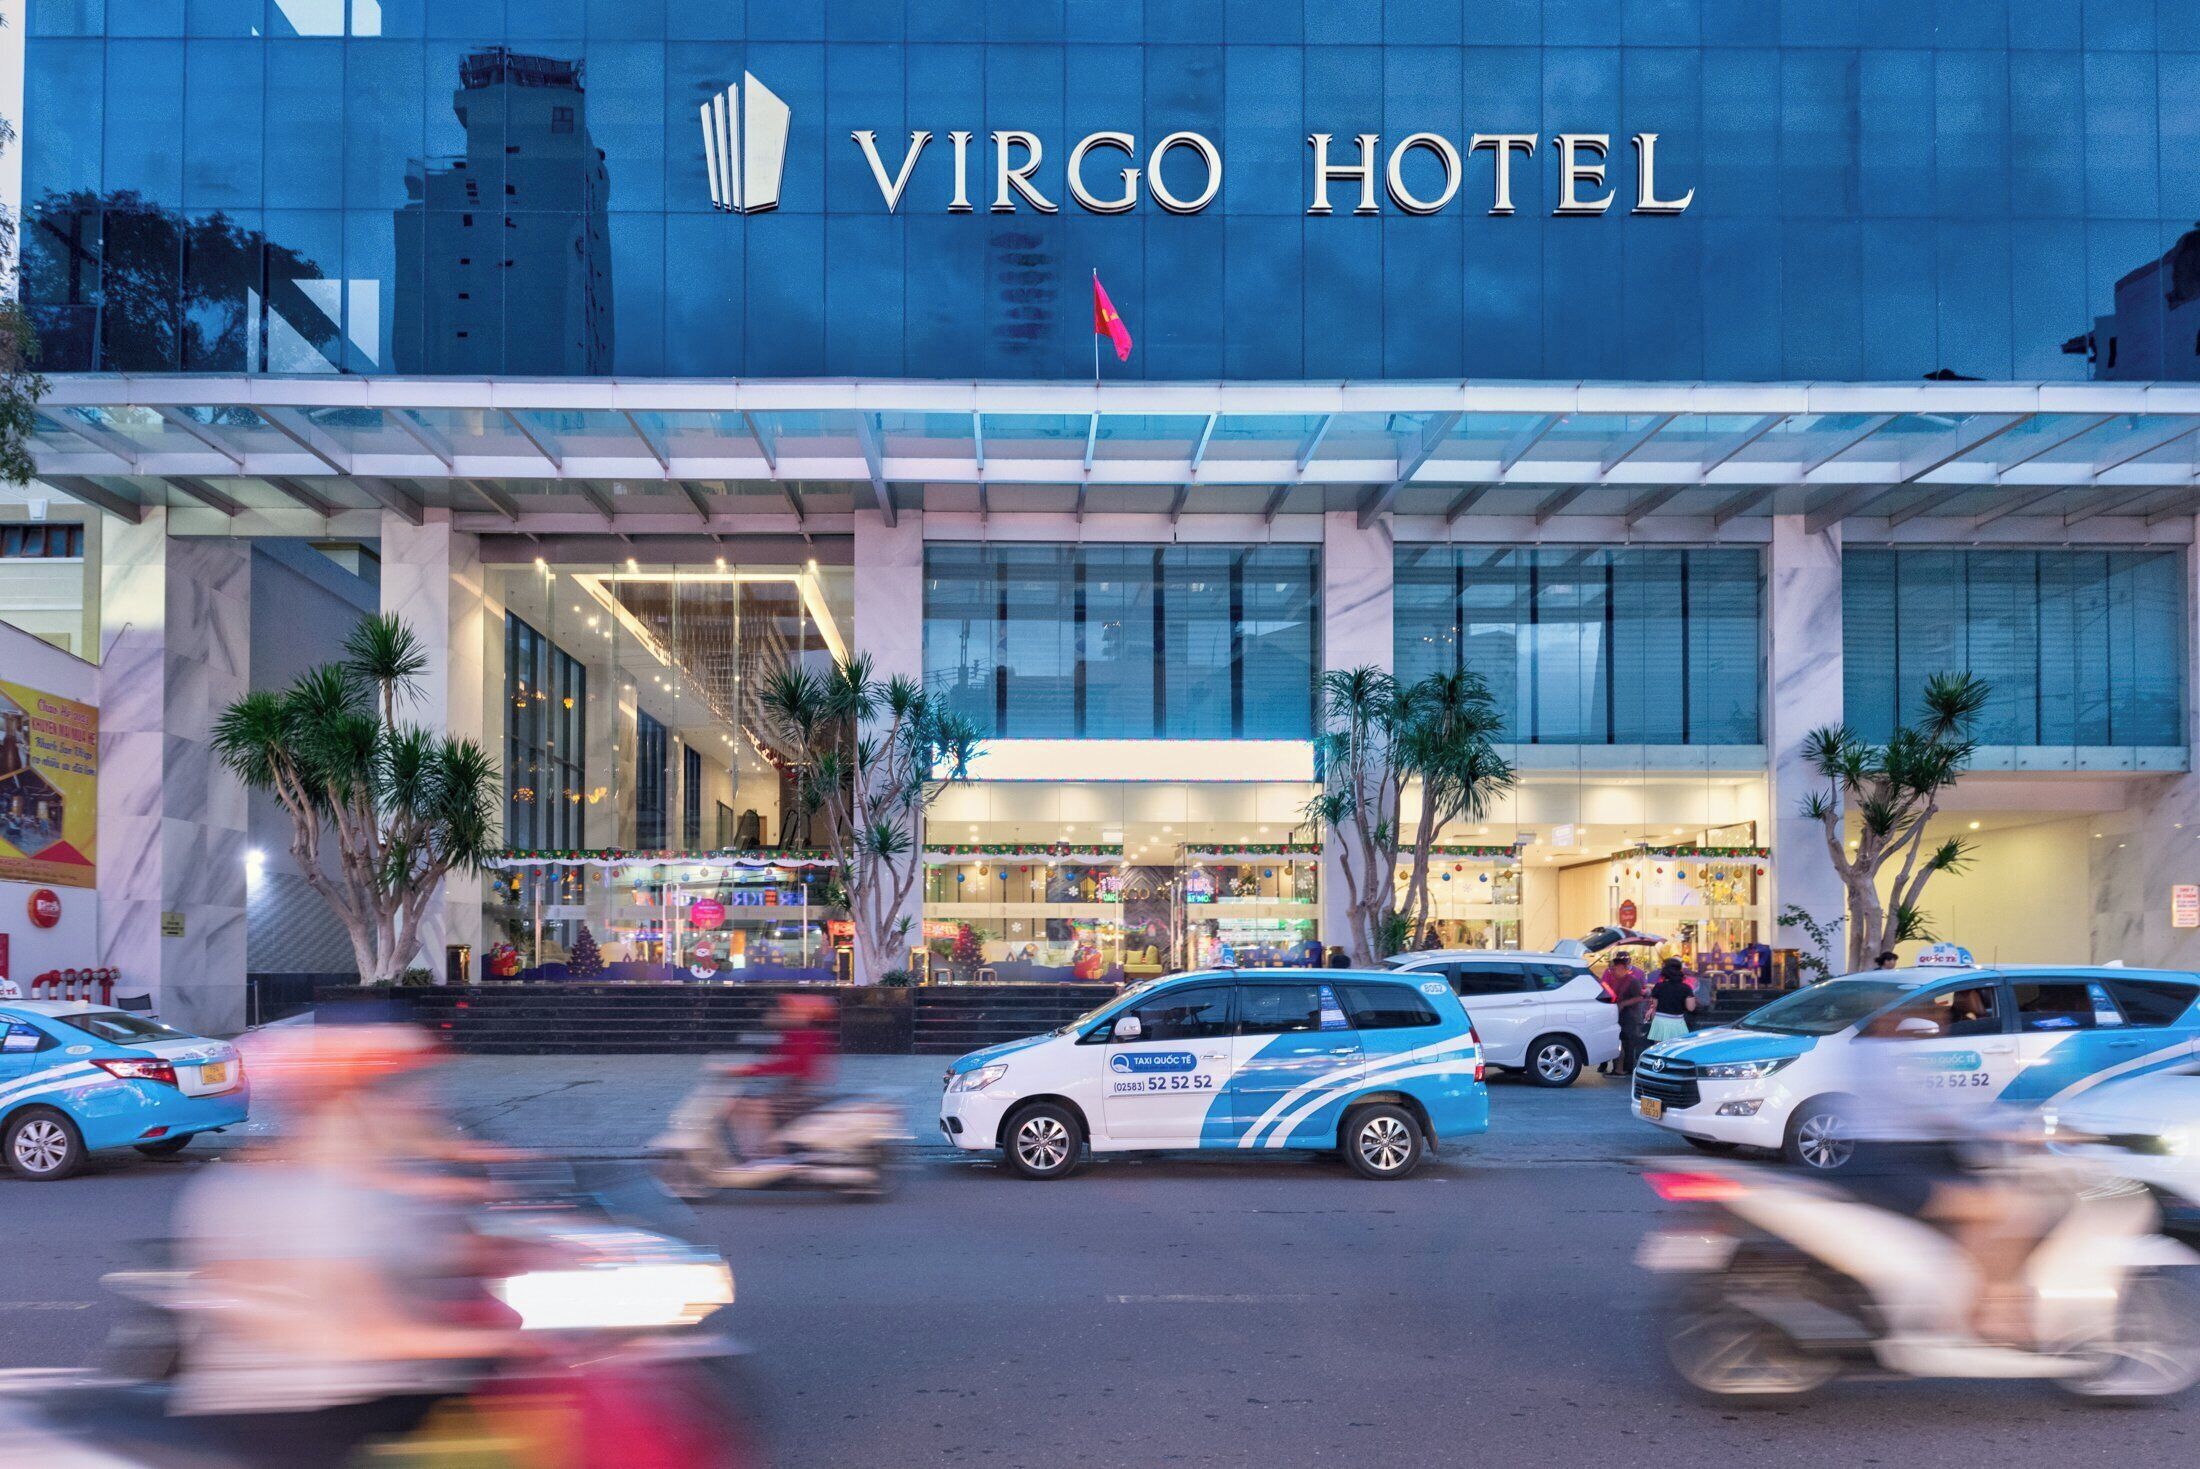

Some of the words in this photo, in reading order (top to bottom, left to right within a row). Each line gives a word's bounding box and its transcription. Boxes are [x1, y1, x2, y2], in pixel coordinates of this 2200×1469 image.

[850, 130, 1222, 214] VIRGO
[1307, 131, 1696, 216] HOTEL
[1133, 1057, 1152, 1065] TAXI
[1153, 1054, 1179, 1065] QUỐC
[1182, 1053, 1192, 1064] TẾ
[1113, 1081, 1145, 1093] (02583)
[1148, 1076, 1167, 1091] 52
[1171, 1075, 1190, 1089] 52
[1194, 1074, 1213, 1089] 52
[1926, 1075, 1945, 1089] 52
[1948, 1074, 1967, 1088] 52
[1971, 1072, 1990, 1087] 52
